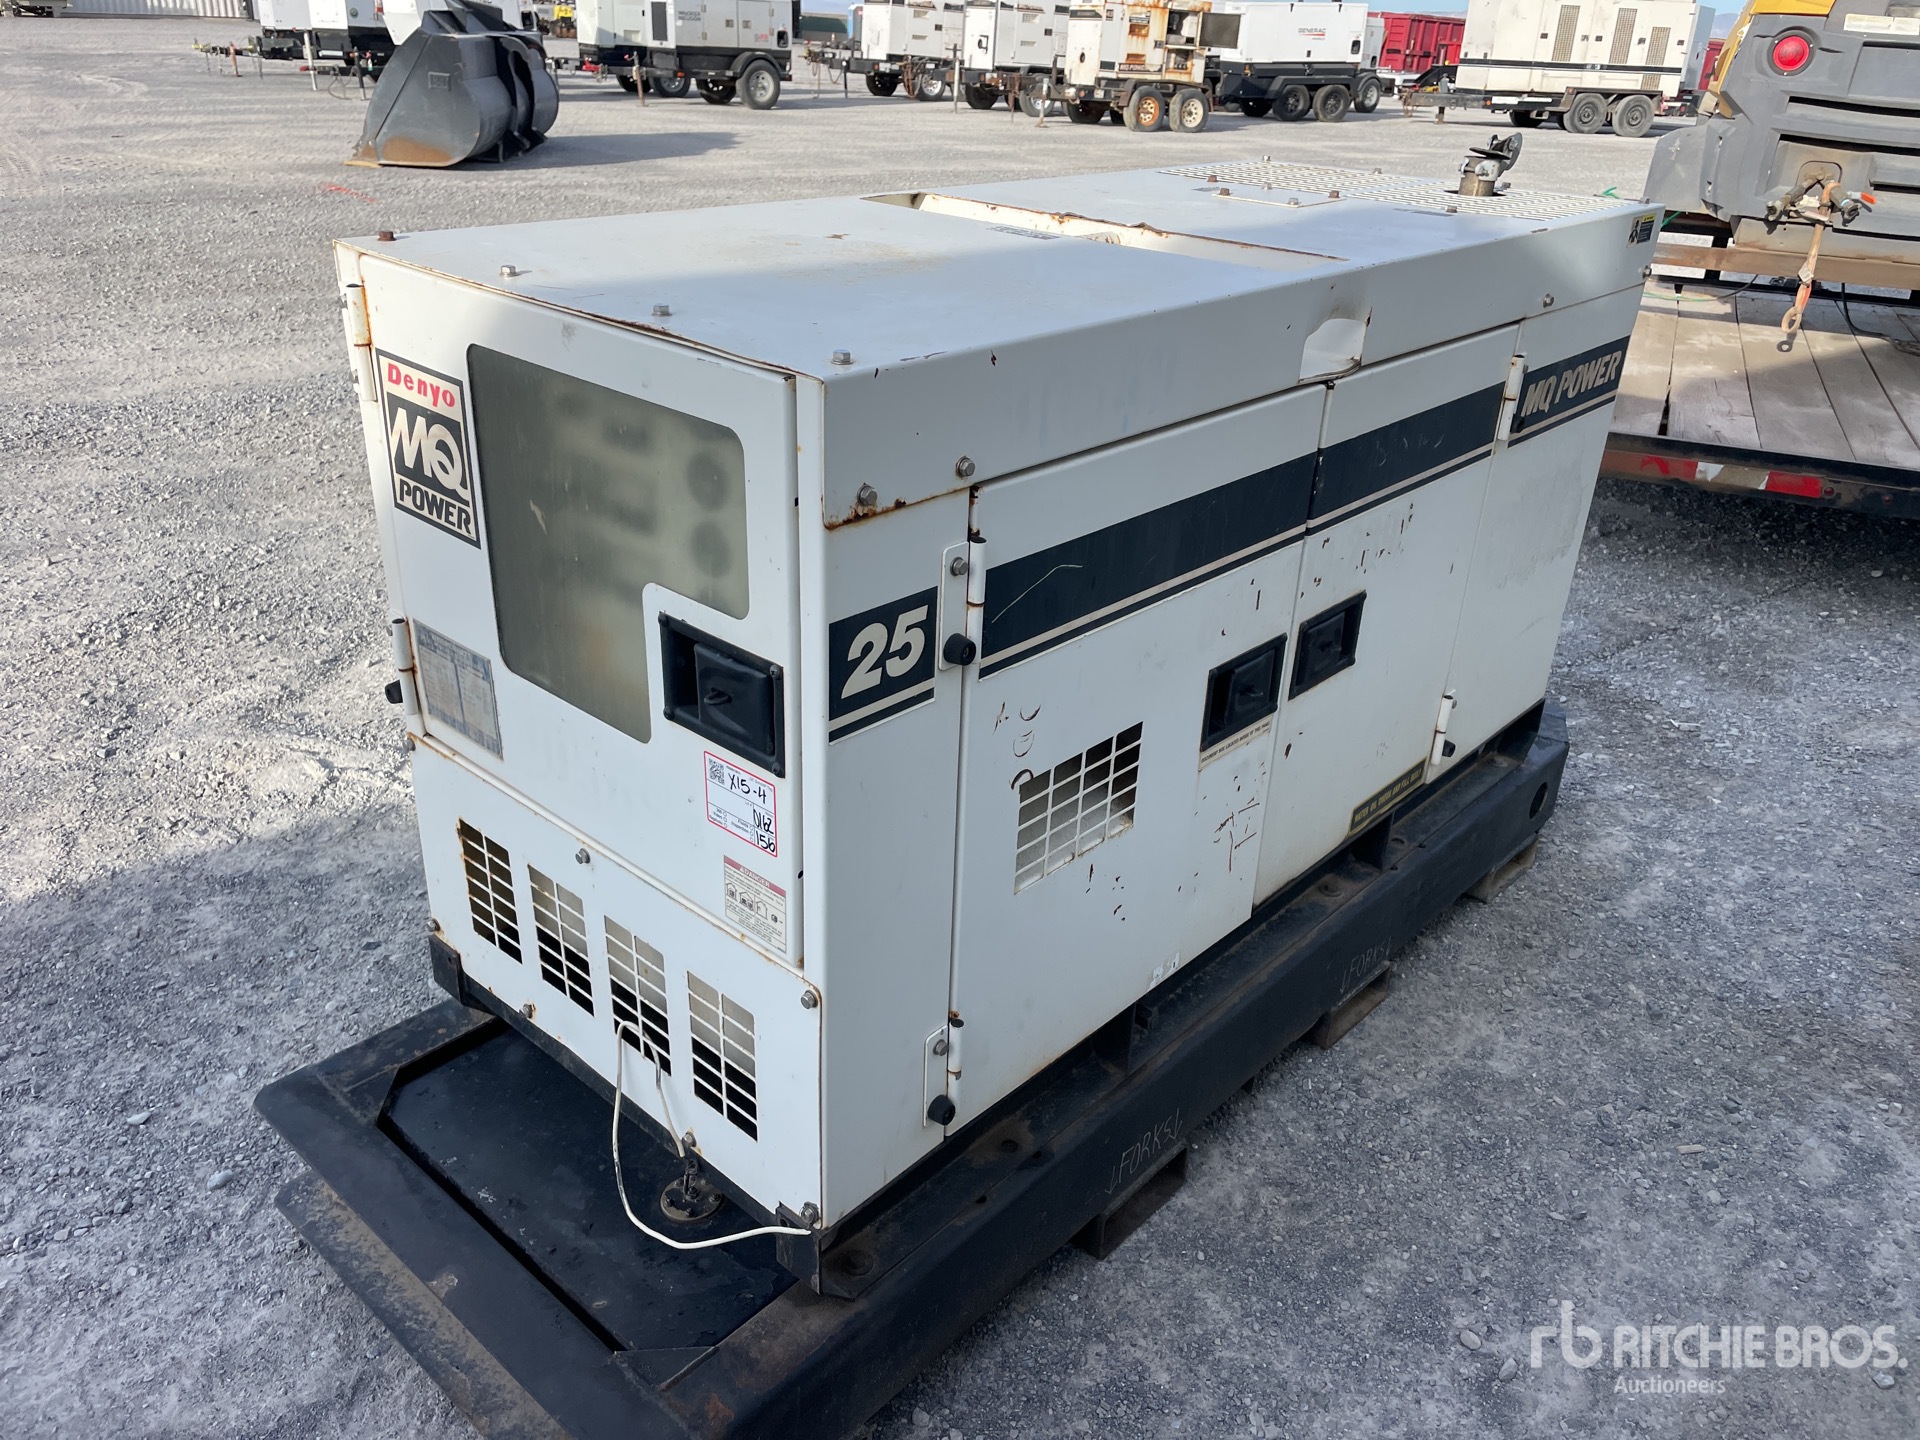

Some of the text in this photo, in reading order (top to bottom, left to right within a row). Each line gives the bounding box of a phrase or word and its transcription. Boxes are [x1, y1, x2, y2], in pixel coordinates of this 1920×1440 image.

[388, 363, 456, 408] Denyo
[1521, 351, 1622, 417] MQ POWER
[391, 407, 470, 501] MQ
[400, 478, 471, 534] POWER
[841, 604, 928, 699] 25
[744, 868, 770, 888] DANGER
[1118, 1115, 1173, 1184] FORKS
